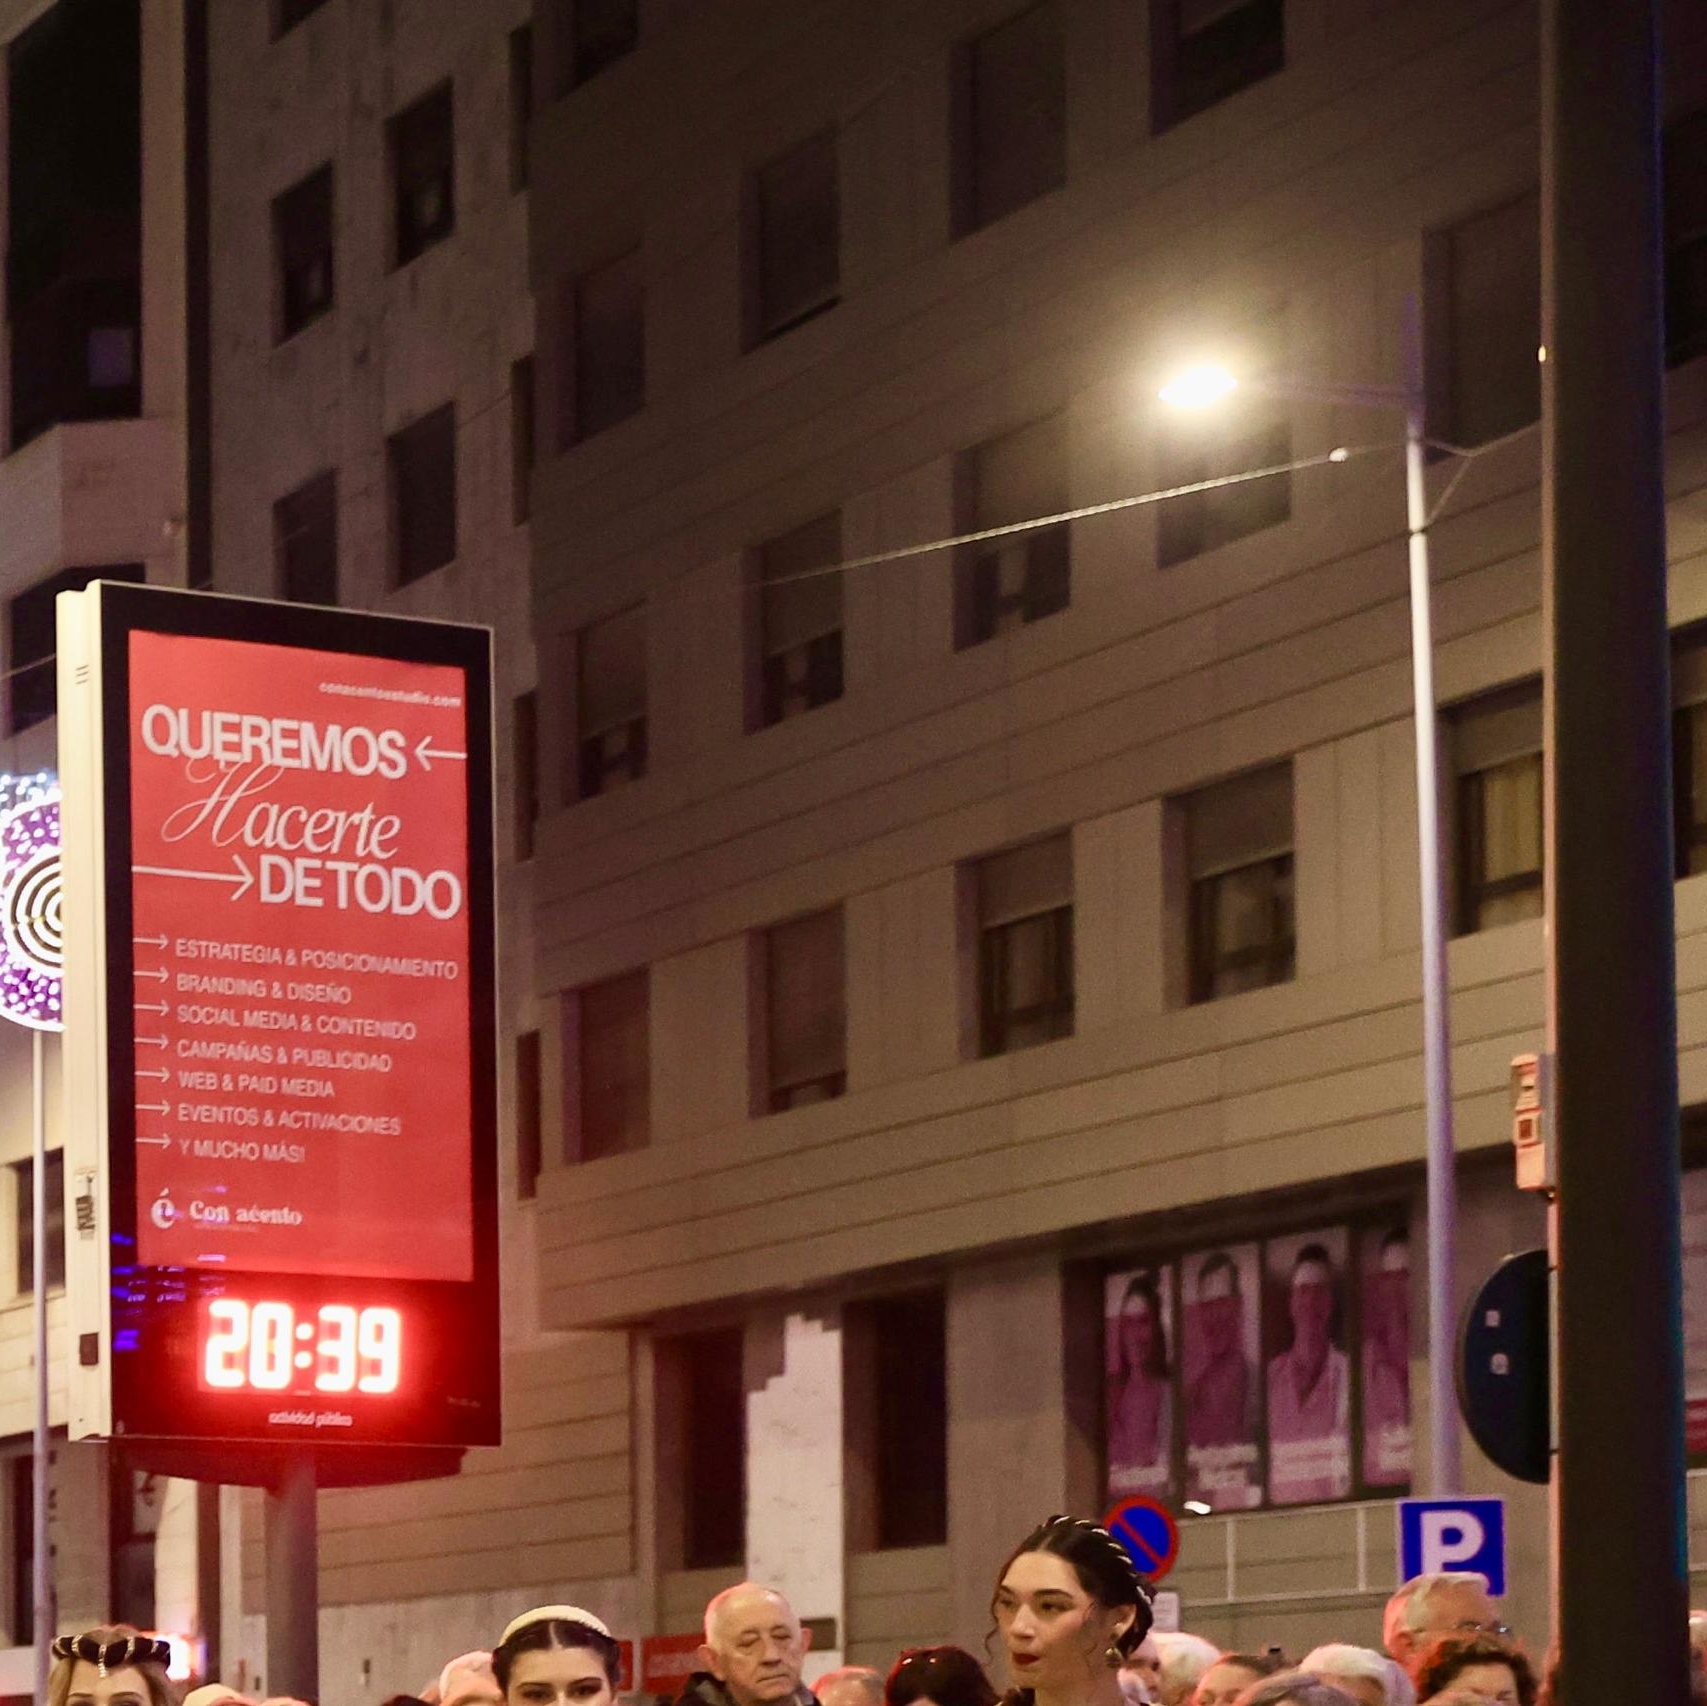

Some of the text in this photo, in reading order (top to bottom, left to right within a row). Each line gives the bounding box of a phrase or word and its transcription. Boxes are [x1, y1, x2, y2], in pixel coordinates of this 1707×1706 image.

[141, 703, 408, 779] QUEREMOS
[161, 757, 401, 859] Hacerte
[175, 938, 459, 980] ESTRATEGIA & POSICIONAMIENTO
[176, 973, 352, 1004] BRANDING & DISEÑO
[177, 1004, 417, 1041] SOCIAL MEDIA & CONTENIDO
[177, 1038, 393, 1073] CAMPAÑAS & PUBLICIDAD
[178, 1070, 336, 1098] WEB & PAID MEDIA
[178, 1102, 402, 1136] EVENTOS & ACTIVACIONES
[179, 1138, 190, 1155] Y
[193, 1139, 261, 1161] MUCHO
[189, 1200, 231, 1222] Con
[204, 1298, 402, 1394] 20:39
[1419, 1508, 1485, 1576] P
